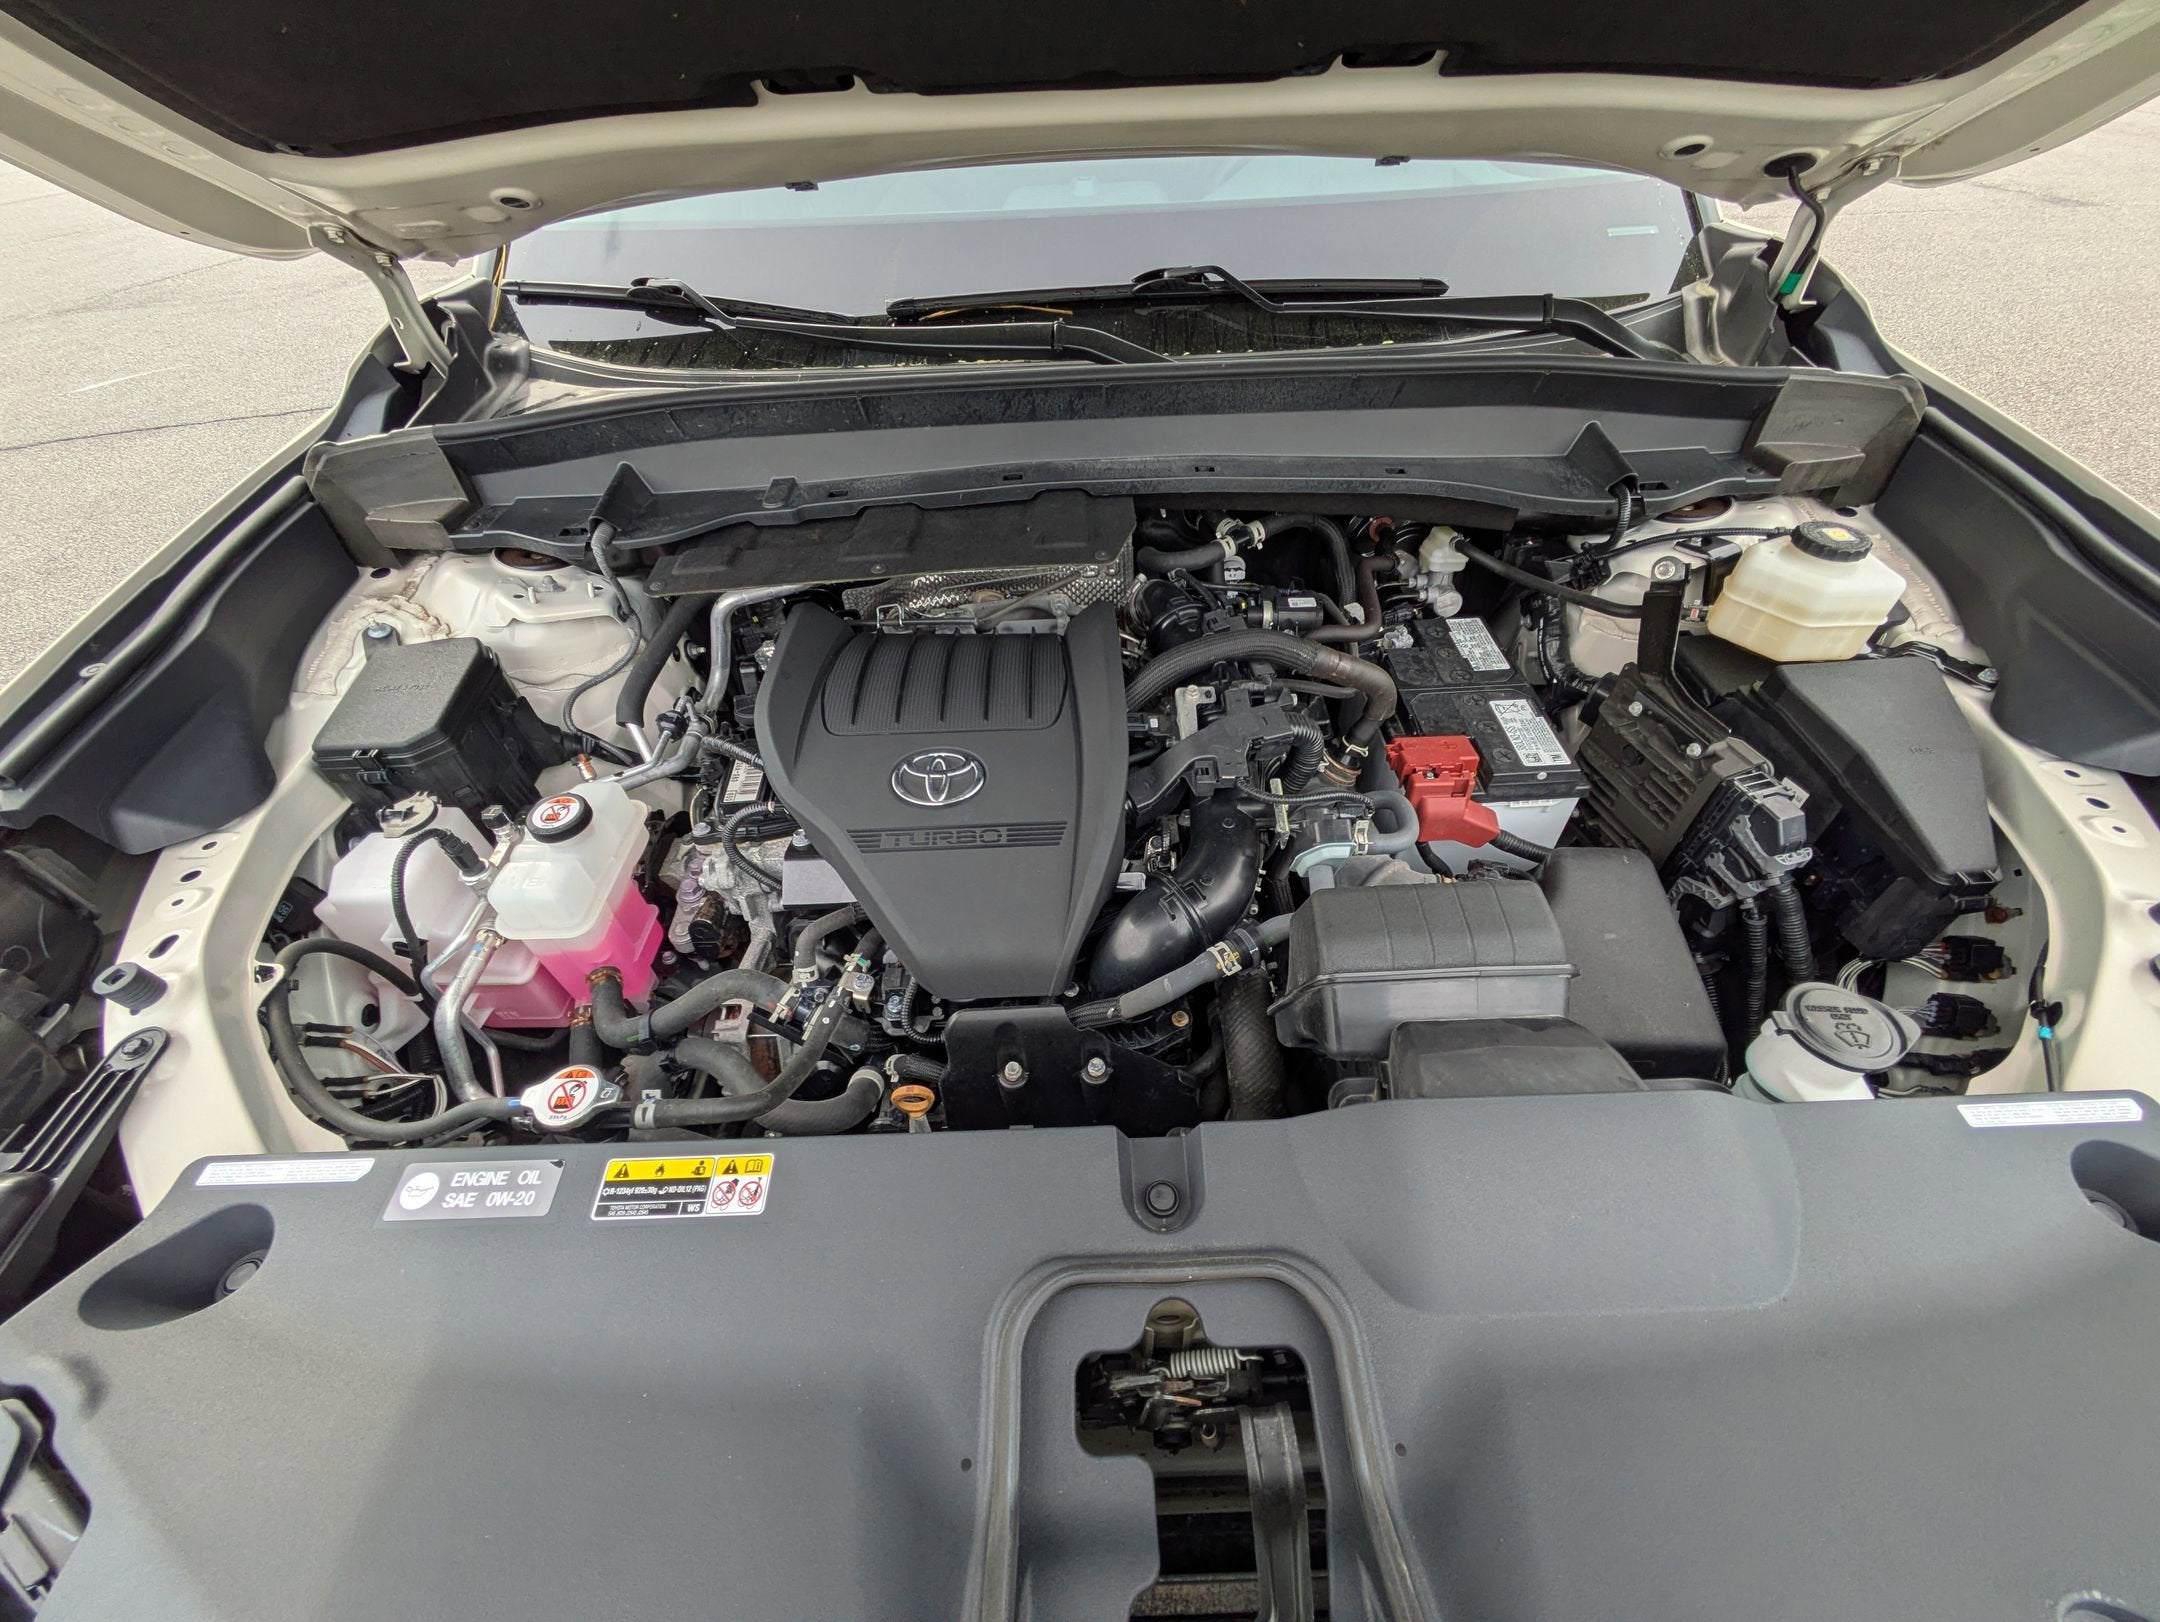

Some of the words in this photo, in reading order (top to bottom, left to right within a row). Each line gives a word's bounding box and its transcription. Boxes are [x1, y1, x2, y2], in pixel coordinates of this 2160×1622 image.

[885, 829, 1003, 847] TURBO
[450, 1171, 511, 1187] ENGINE
[517, 1170, 542, 1185] OIL
[441, 1192, 478, 1208] SAE
[486, 1191, 536, 1207] 0W-20
[687, 1204, 701, 1213] WS
